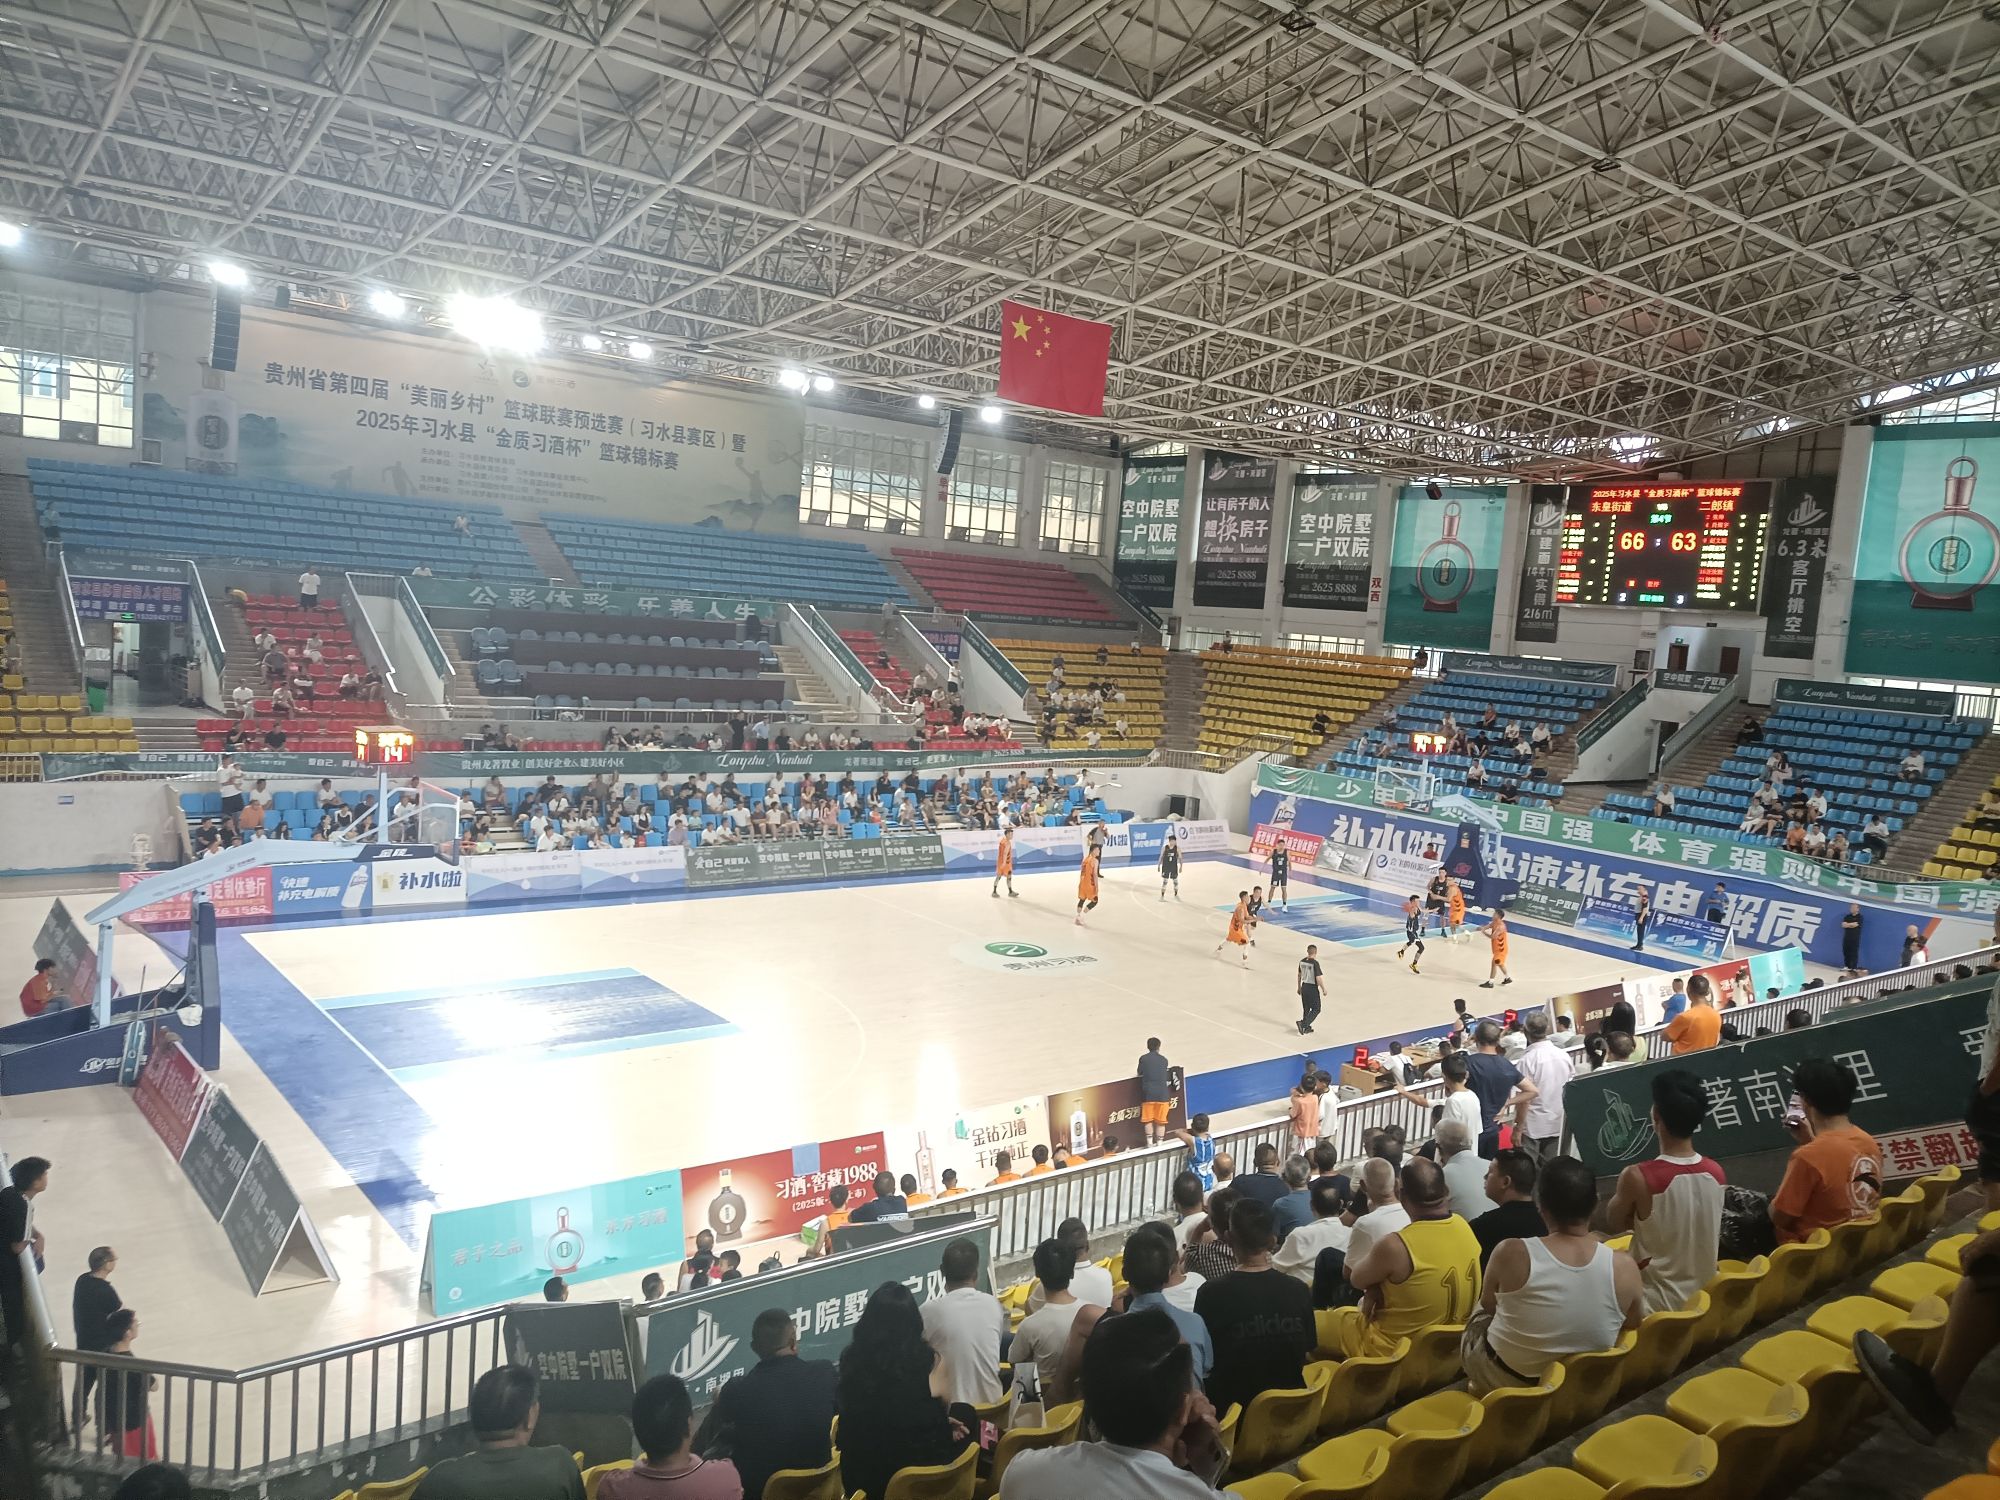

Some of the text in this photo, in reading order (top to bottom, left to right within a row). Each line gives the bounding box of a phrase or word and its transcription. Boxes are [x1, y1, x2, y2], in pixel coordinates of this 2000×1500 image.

[1122, 499, 1179, 518] 空中院墅
[1206, 497, 1270, 512] 让有房子的人
[1591, 501, 1633, 512] 东皇街道
[1699, 500, 1734, 511] 二郎镇
[1119, 523, 1177, 542] 一户双院
[1203, 512, 1269, 543] 想换房子
[1299, 513, 1373, 534] 空中院墅
[1297, 536, 1371, 557] 一户双院
[1621, 532, 1645, 550] 66
[1671, 532, 1697, 551] 63
[1311, 582, 1358, 594] 2625 8888
[636, 596, 757, 622] 乐善人生
[383, 746, 403, 762] 14
[1103, 833, 1128, 847] 水啦
[1330, 812, 1447, 861] 补水啦
[280, 876, 311, 888] 快速
[399, 870, 462, 889] 补水啦
[1355, 1048, 1368, 1067] 2
[1694, 1050, 1888, 1133] 著南里
[972, 1118, 1027, 1147] 金钻习酒
[1438, 1258, 1479, 1325] 11
[537, 1348, 627, 1380] 空中院墅一户双院
